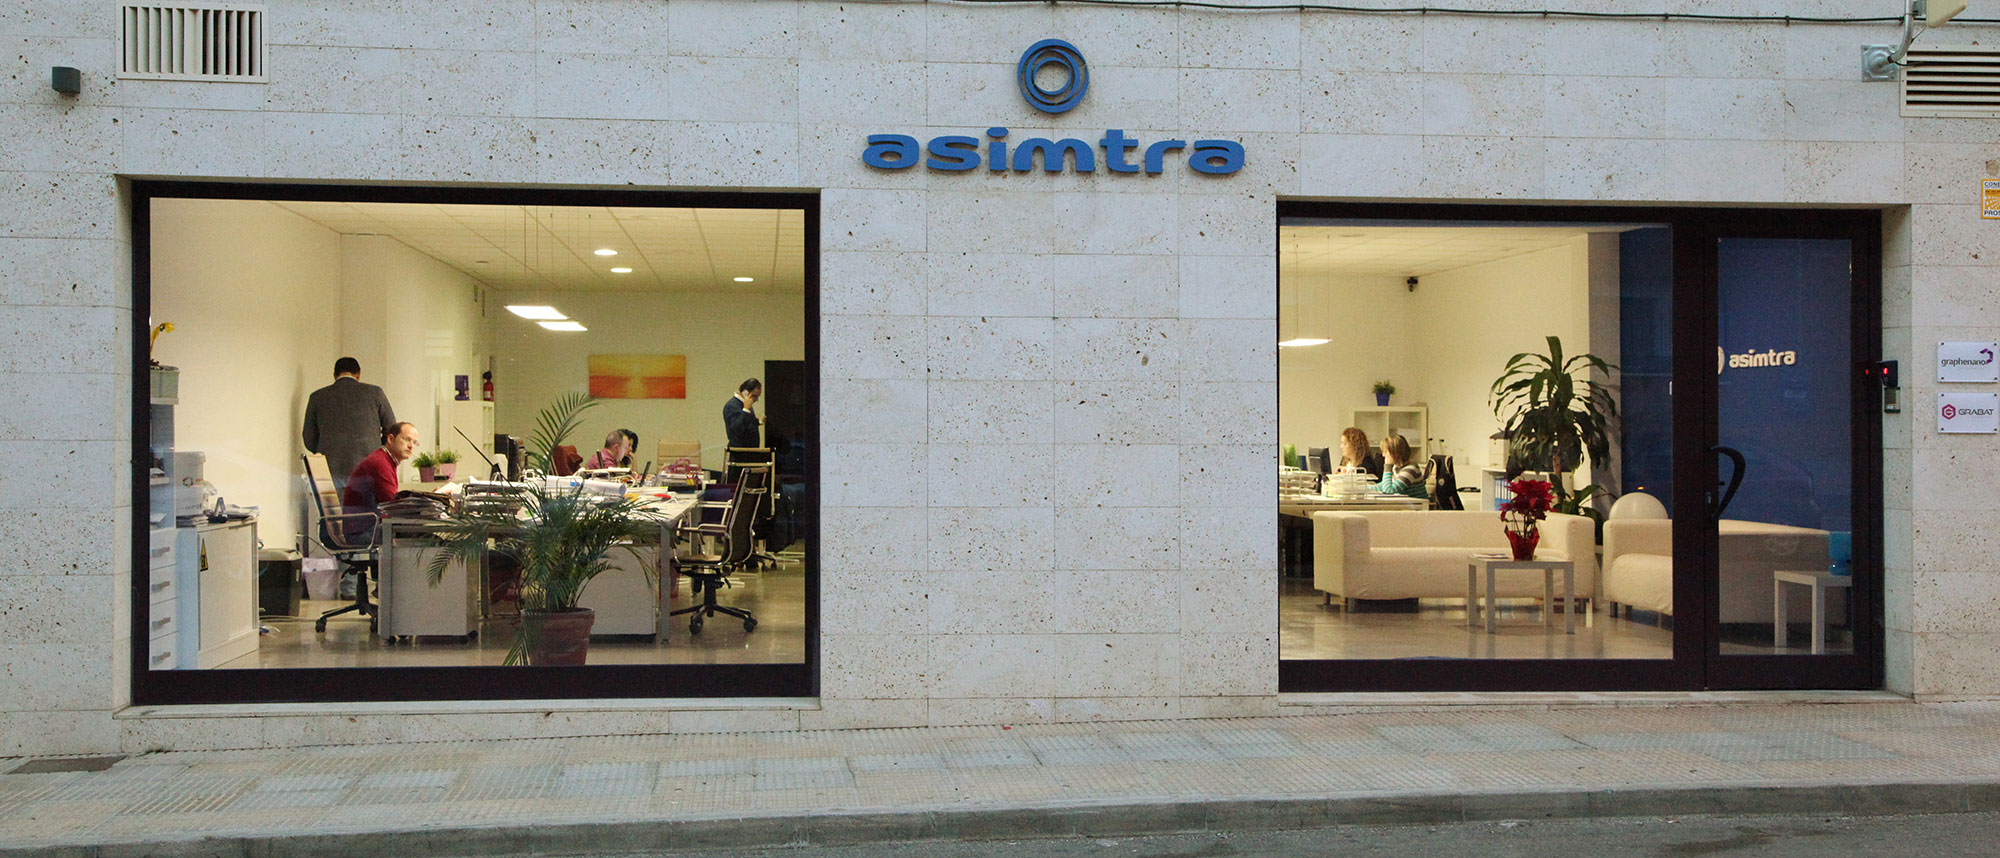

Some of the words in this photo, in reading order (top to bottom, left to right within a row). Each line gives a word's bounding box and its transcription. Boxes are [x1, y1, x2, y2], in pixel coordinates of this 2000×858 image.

[862, 127, 1246, 174] asimtra
[1729, 348, 1796, 368] asimtra
[1941, 358, 1986, 367] graphenano
[1958, 408, 1994, 416] GRABAT
